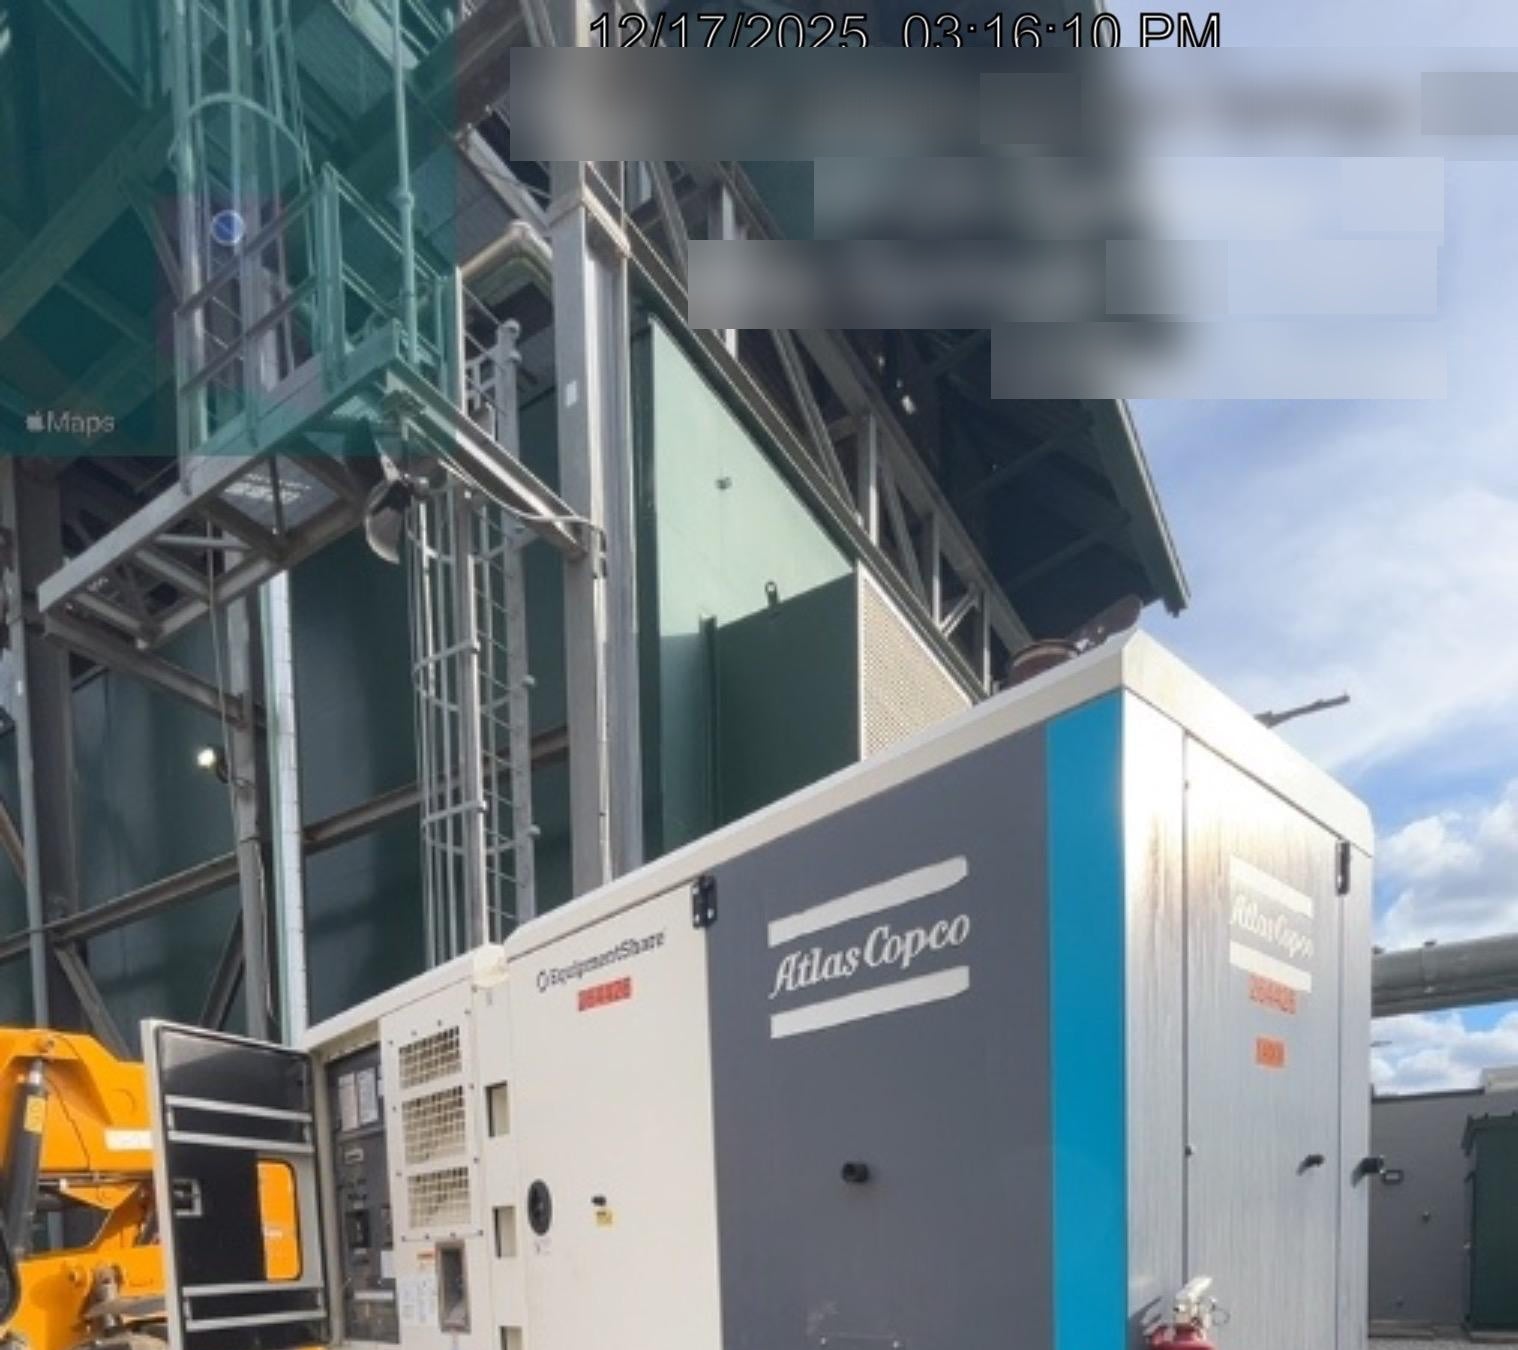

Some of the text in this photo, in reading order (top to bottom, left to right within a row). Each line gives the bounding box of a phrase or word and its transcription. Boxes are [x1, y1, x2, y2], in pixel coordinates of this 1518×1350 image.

[551, 932, 665, 985] EquipmentShare
[768, 914, 970, 1000] Atlas Copco
